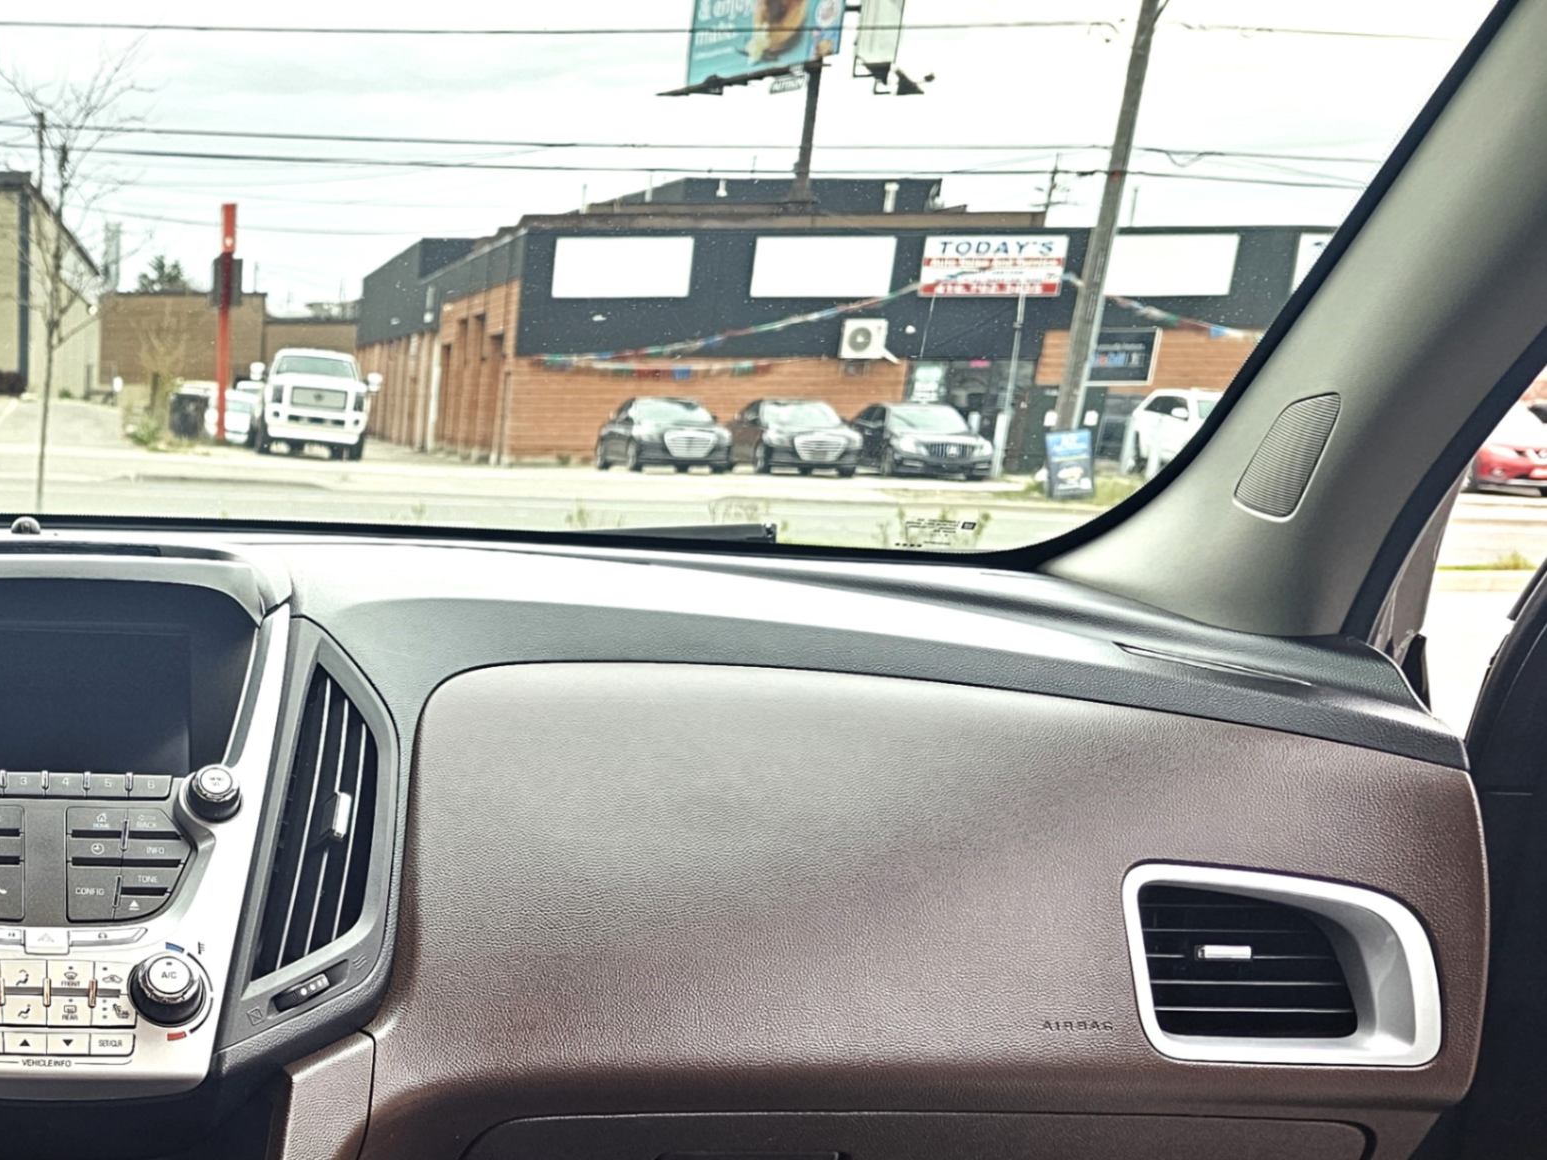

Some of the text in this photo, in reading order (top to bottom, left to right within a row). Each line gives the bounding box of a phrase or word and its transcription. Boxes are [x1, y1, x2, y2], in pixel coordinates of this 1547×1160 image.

[940, 241, 1055, 256] TODAY'S
[20, 776, 28, 785] 3
[61, 777, 69, 786] 4
[104, 778, 112, 787] 5
[147, 780, 155, 789] 6
[146, 847, 165, 855] INFO
[138, 876, 158, 884] TONE
[75, 887, 104, 896] CONFIG
[161, 971, 178, 980] A/C
[1043, 1021, 1114, 1031] AIRBAG
[98, 1039, 123, 1048] SET/CLR
[21, 1059, 71, 1067] VEHICLE INFO
